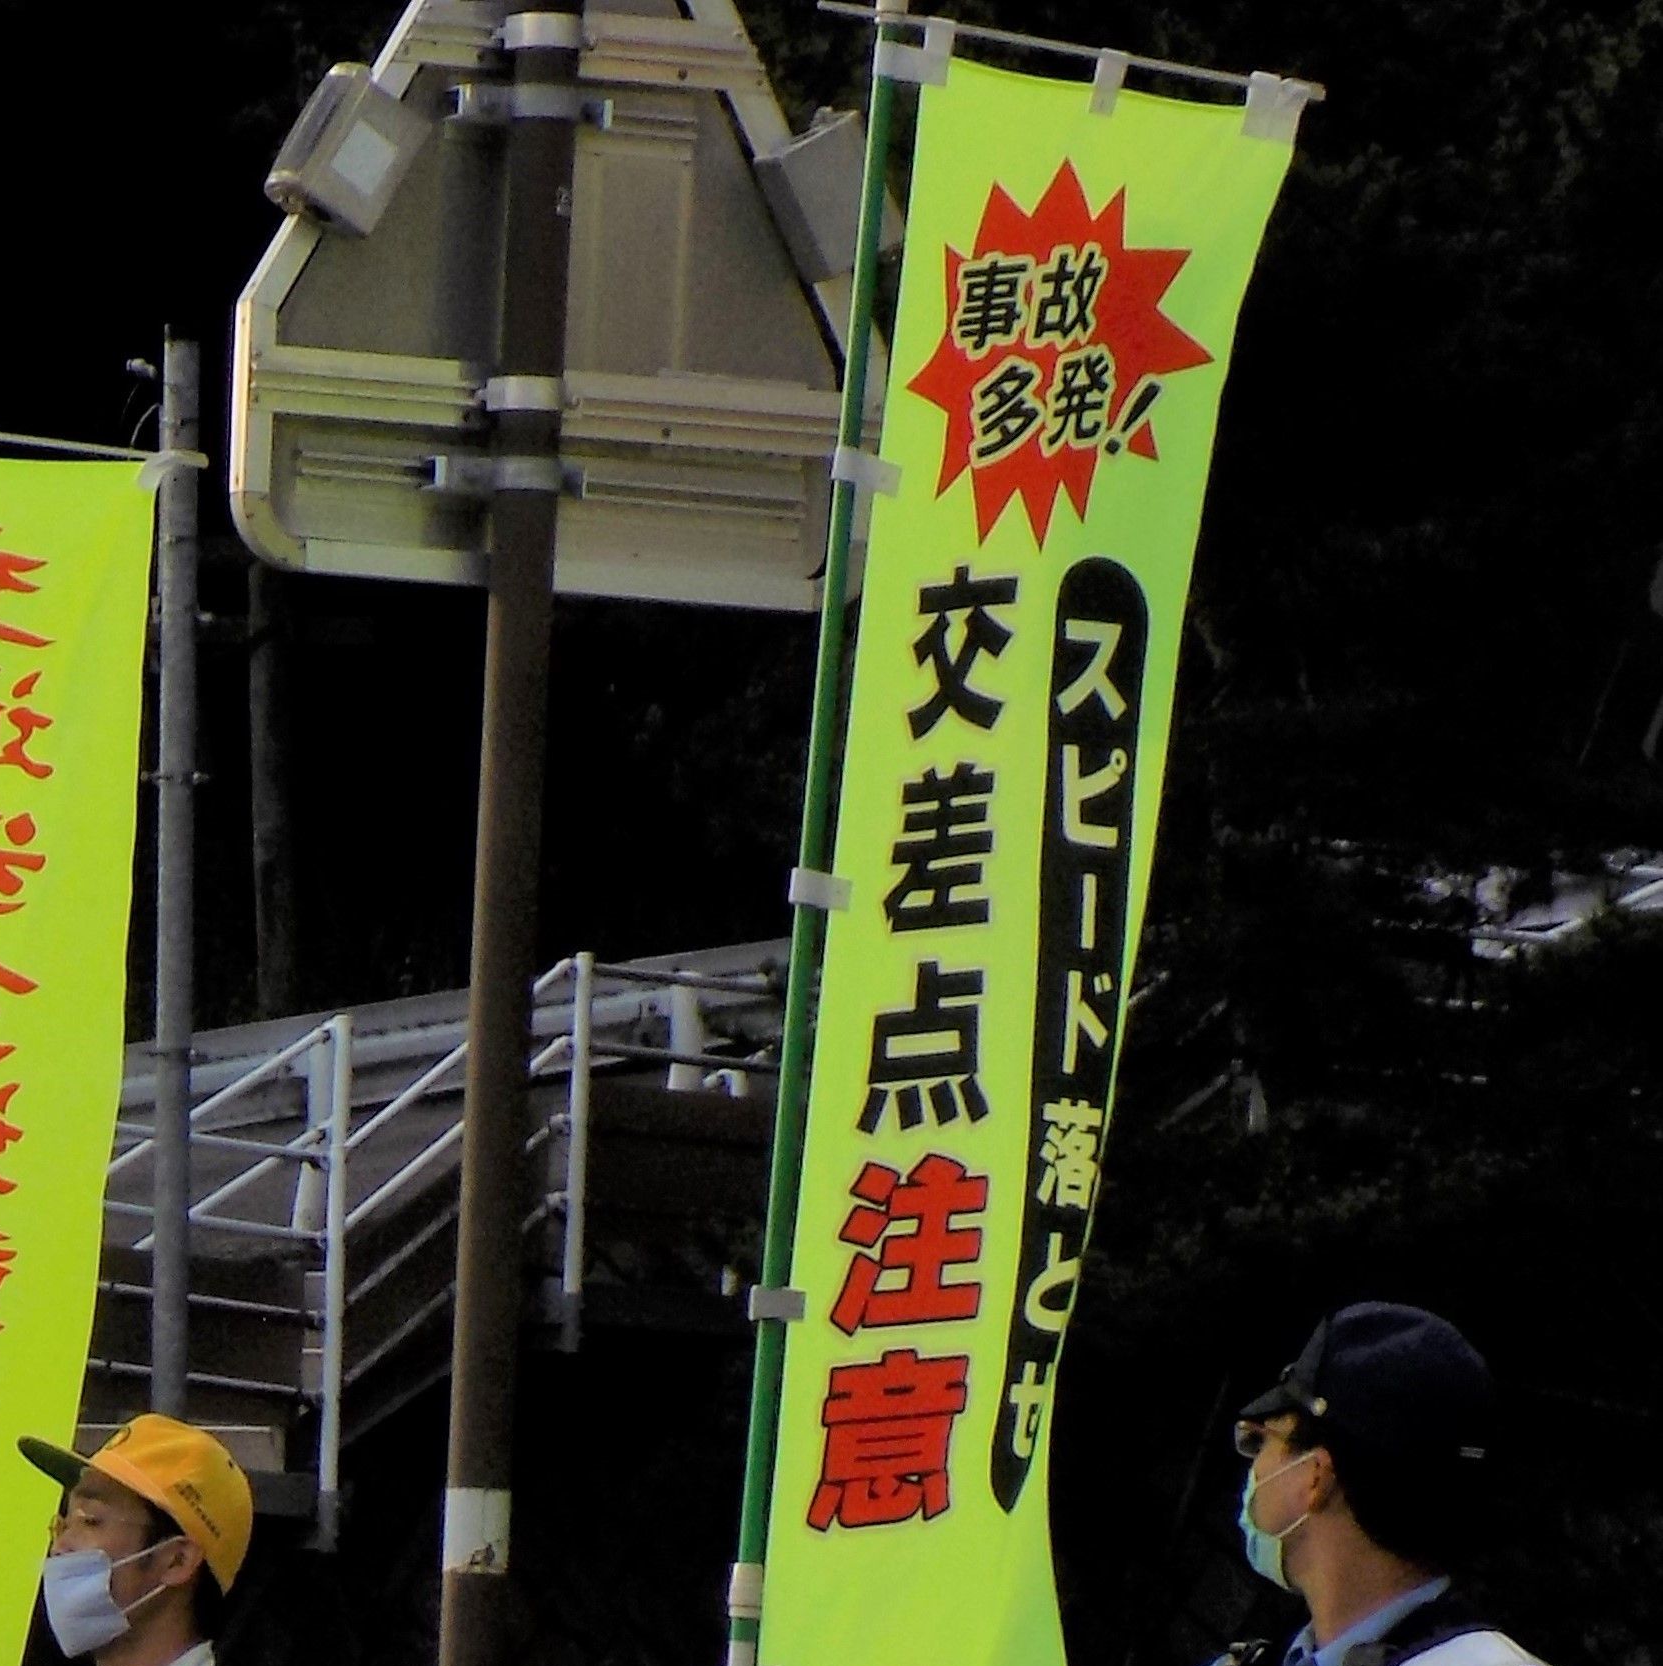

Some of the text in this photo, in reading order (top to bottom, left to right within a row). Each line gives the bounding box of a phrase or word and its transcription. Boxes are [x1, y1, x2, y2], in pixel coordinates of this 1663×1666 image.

[957, 247, 1103, 349] 事故
[1009, 619, 1127, 1459] スピード落とせ
